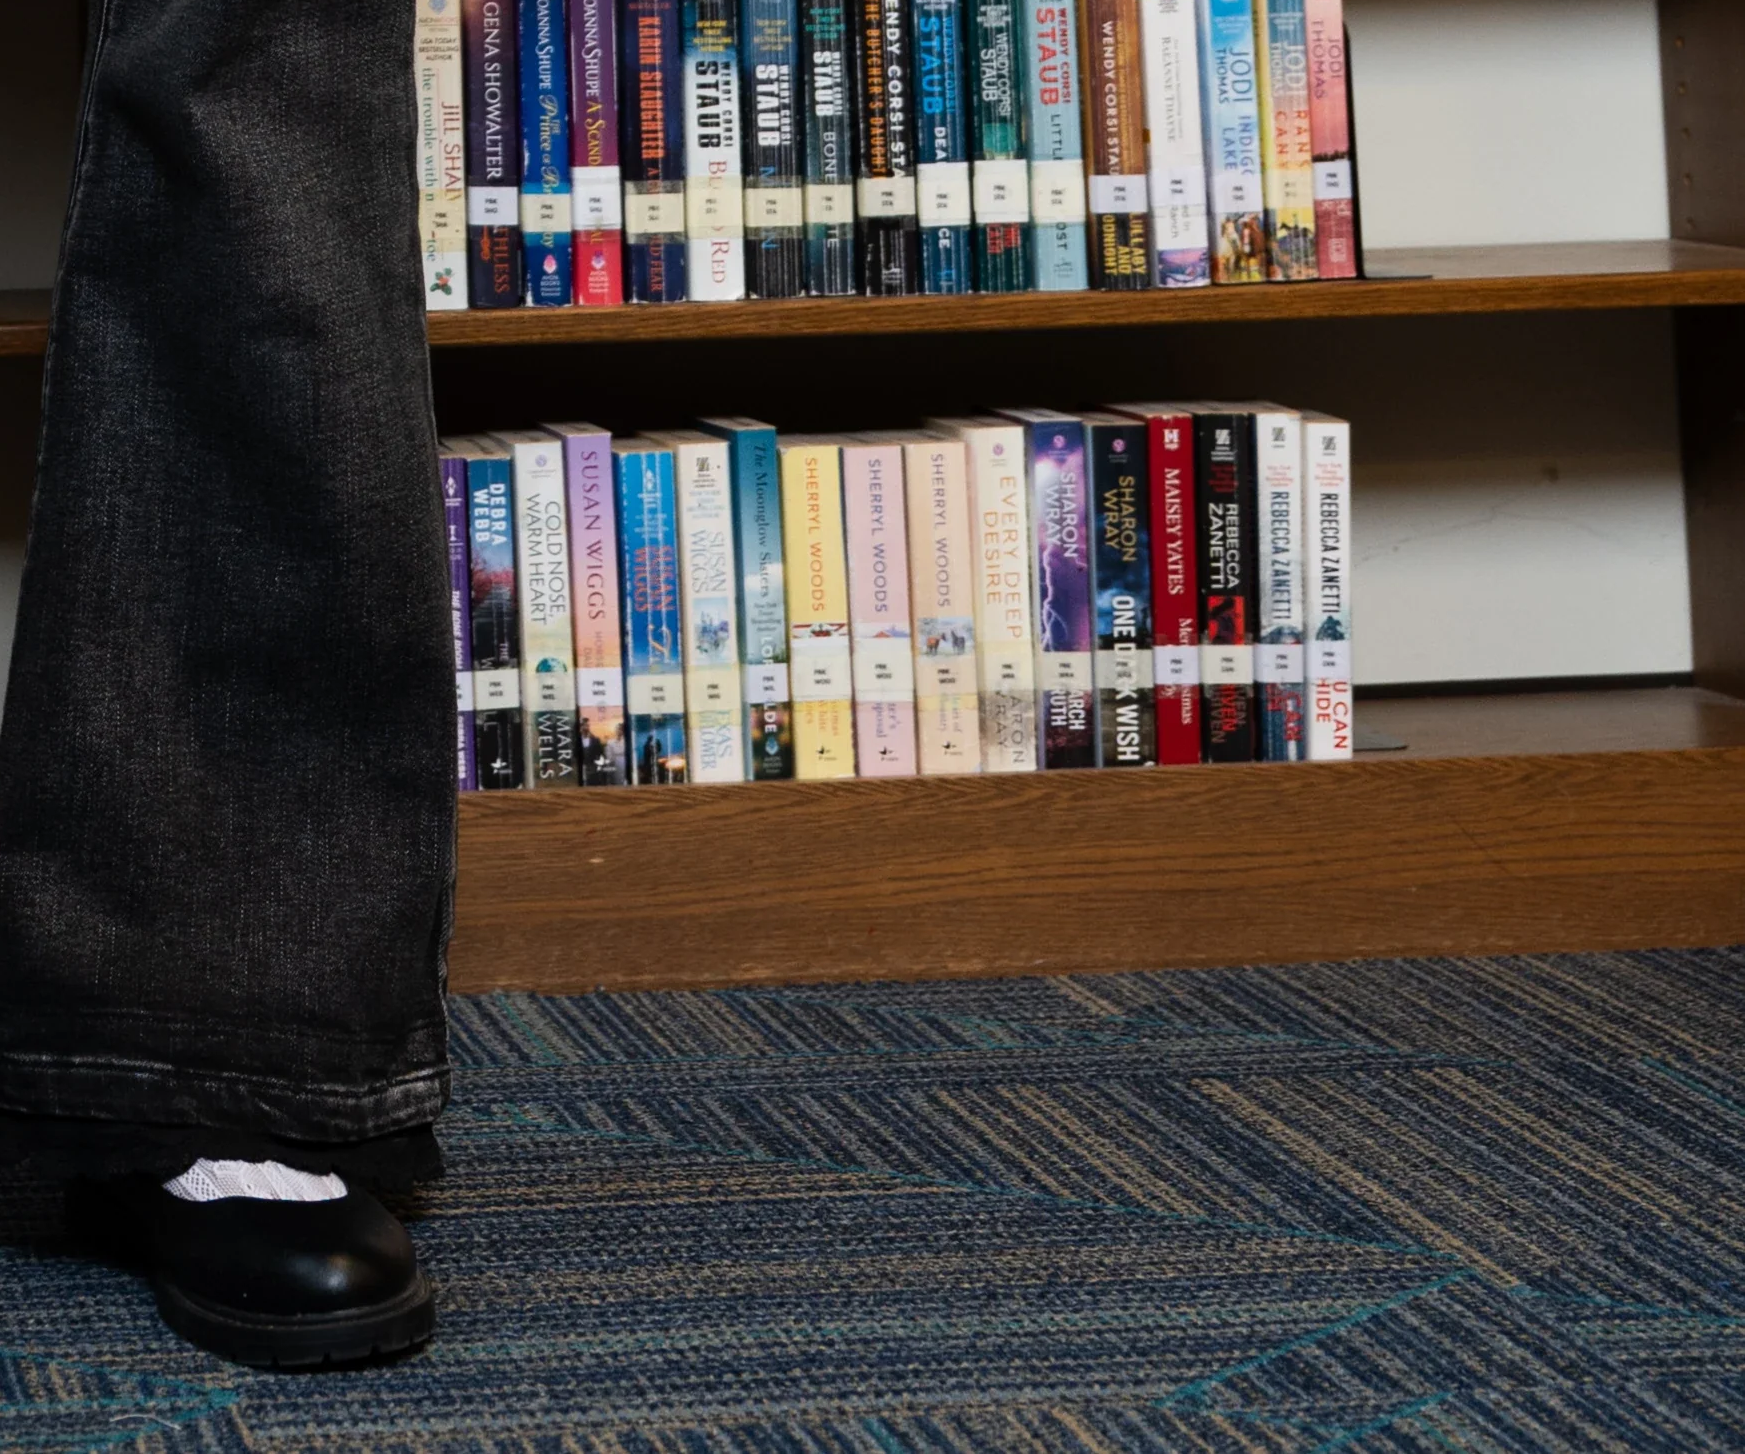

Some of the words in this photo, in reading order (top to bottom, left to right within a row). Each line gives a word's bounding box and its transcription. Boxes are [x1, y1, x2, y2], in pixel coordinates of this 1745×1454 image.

[483, 0, 504, 59] GENA
[638, 15, 662, 65] KARIN
[1035, 6, 1060, 106] STAUB
[1057, 6, 1069, 57] WENDY
[640, 70, 666, 160] SLAUGHTER
[1060, 61, 1071, 104] CORSI
[484, 63, 507, 180] SHOWALTER
[753, 443, 768, 469] The
[580, 450, 604, 533] SUSAN
[751, 472, 774, 548] Moonglow
[867, 458, 886, 536] SHERRYL
[999, 476, 1019, 561] EVERY
[1102, 489, 1122, 550] WRAY
[1114, 475, 1138, 562] SHARON
[1162, 467, 1182, 537] MAISEY
[1319, 492, 1341, 553] REBECCA
[526, 493, 545, 559] WARM
[543, 501, 563, 556] COLD
[982, 510, 1004, 606] DESIRE
[528, 563, 548, 626] HEART
[543, 560, 566, 619] NOSE,
[584, 538, 607, 621] WIGGS
[758, 552, 775, 598] Sisters
[871, 542, 889, 613] WOODS
[1165, 540, 1185, 596] YATES
[1321, 556, 1343, 615] ZANETTI
[1005, 570, 1024, 639] DEEP
[537, 714, 556, 780] WELLS
[555, 714, 573, 777] MARA
